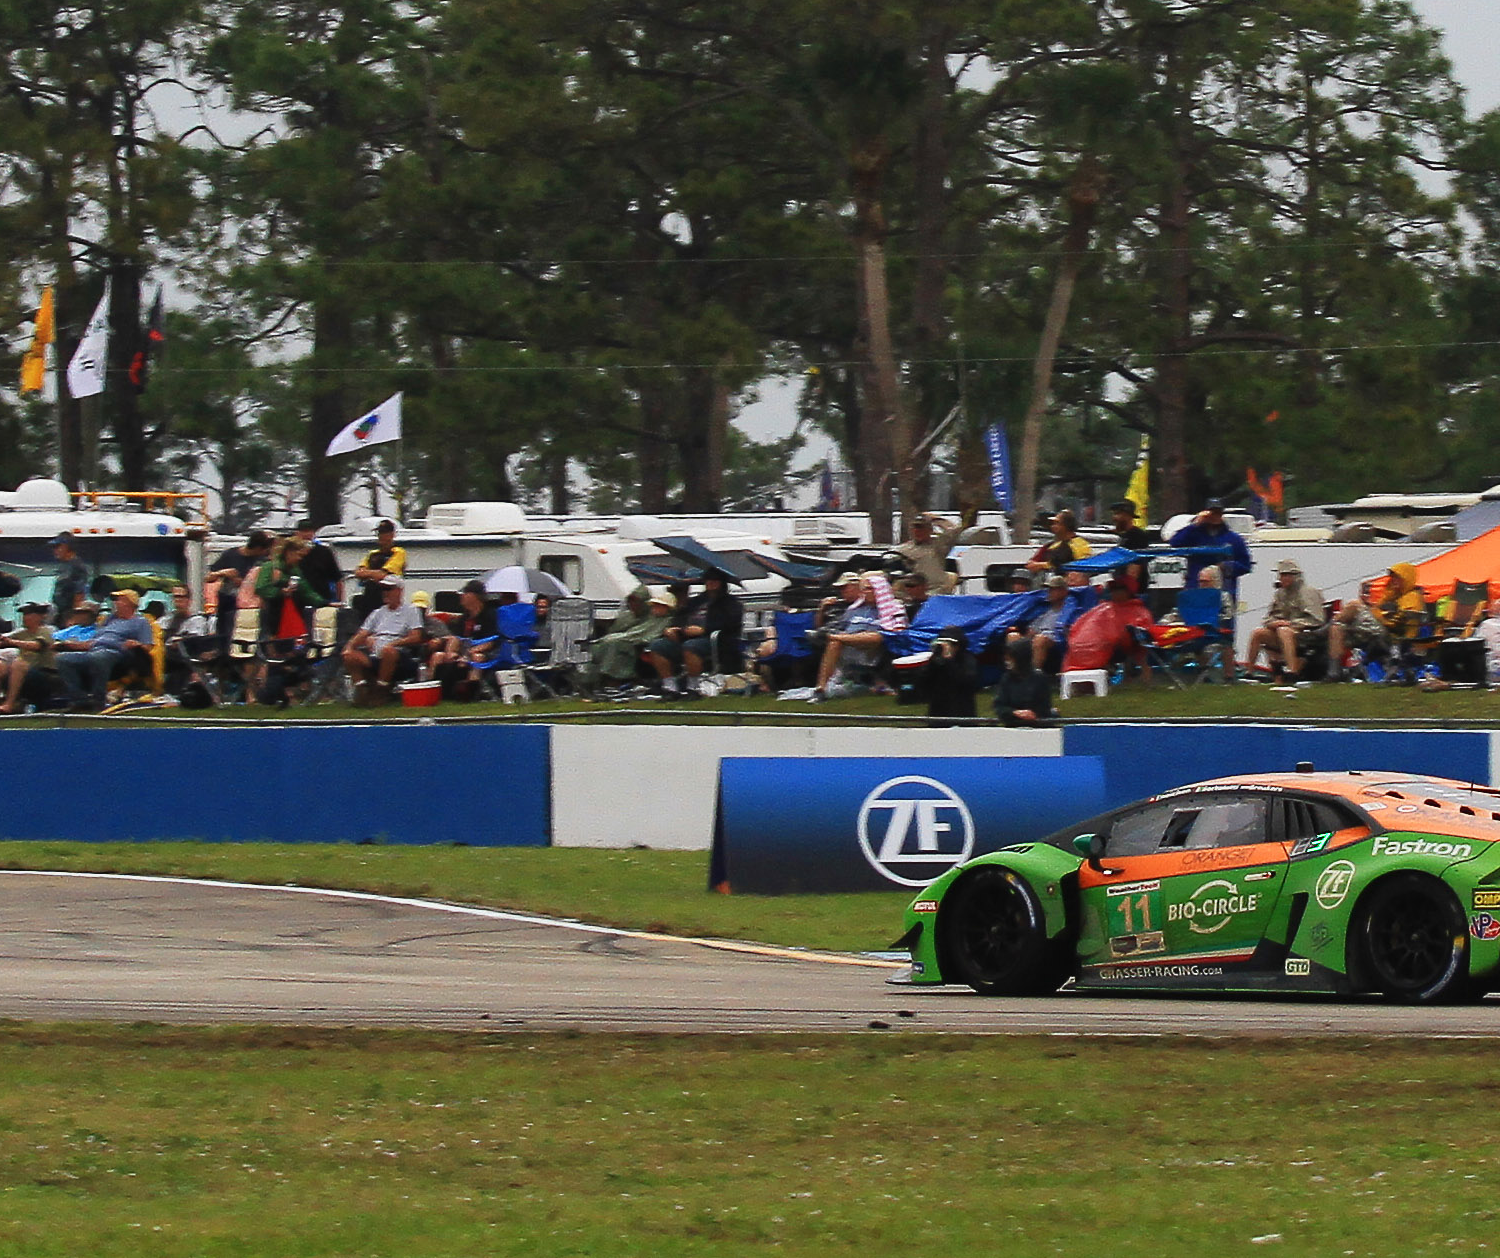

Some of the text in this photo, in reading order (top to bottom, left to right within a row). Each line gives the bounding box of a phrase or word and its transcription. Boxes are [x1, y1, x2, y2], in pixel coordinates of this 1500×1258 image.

[1371, 837, 1472, 858] Fastron
[1117, 894, 1150, 932] 11
[1168, 895, 1257, 921] BIO-CIRCLE
[1287, 961, 1308, 973] GTD
